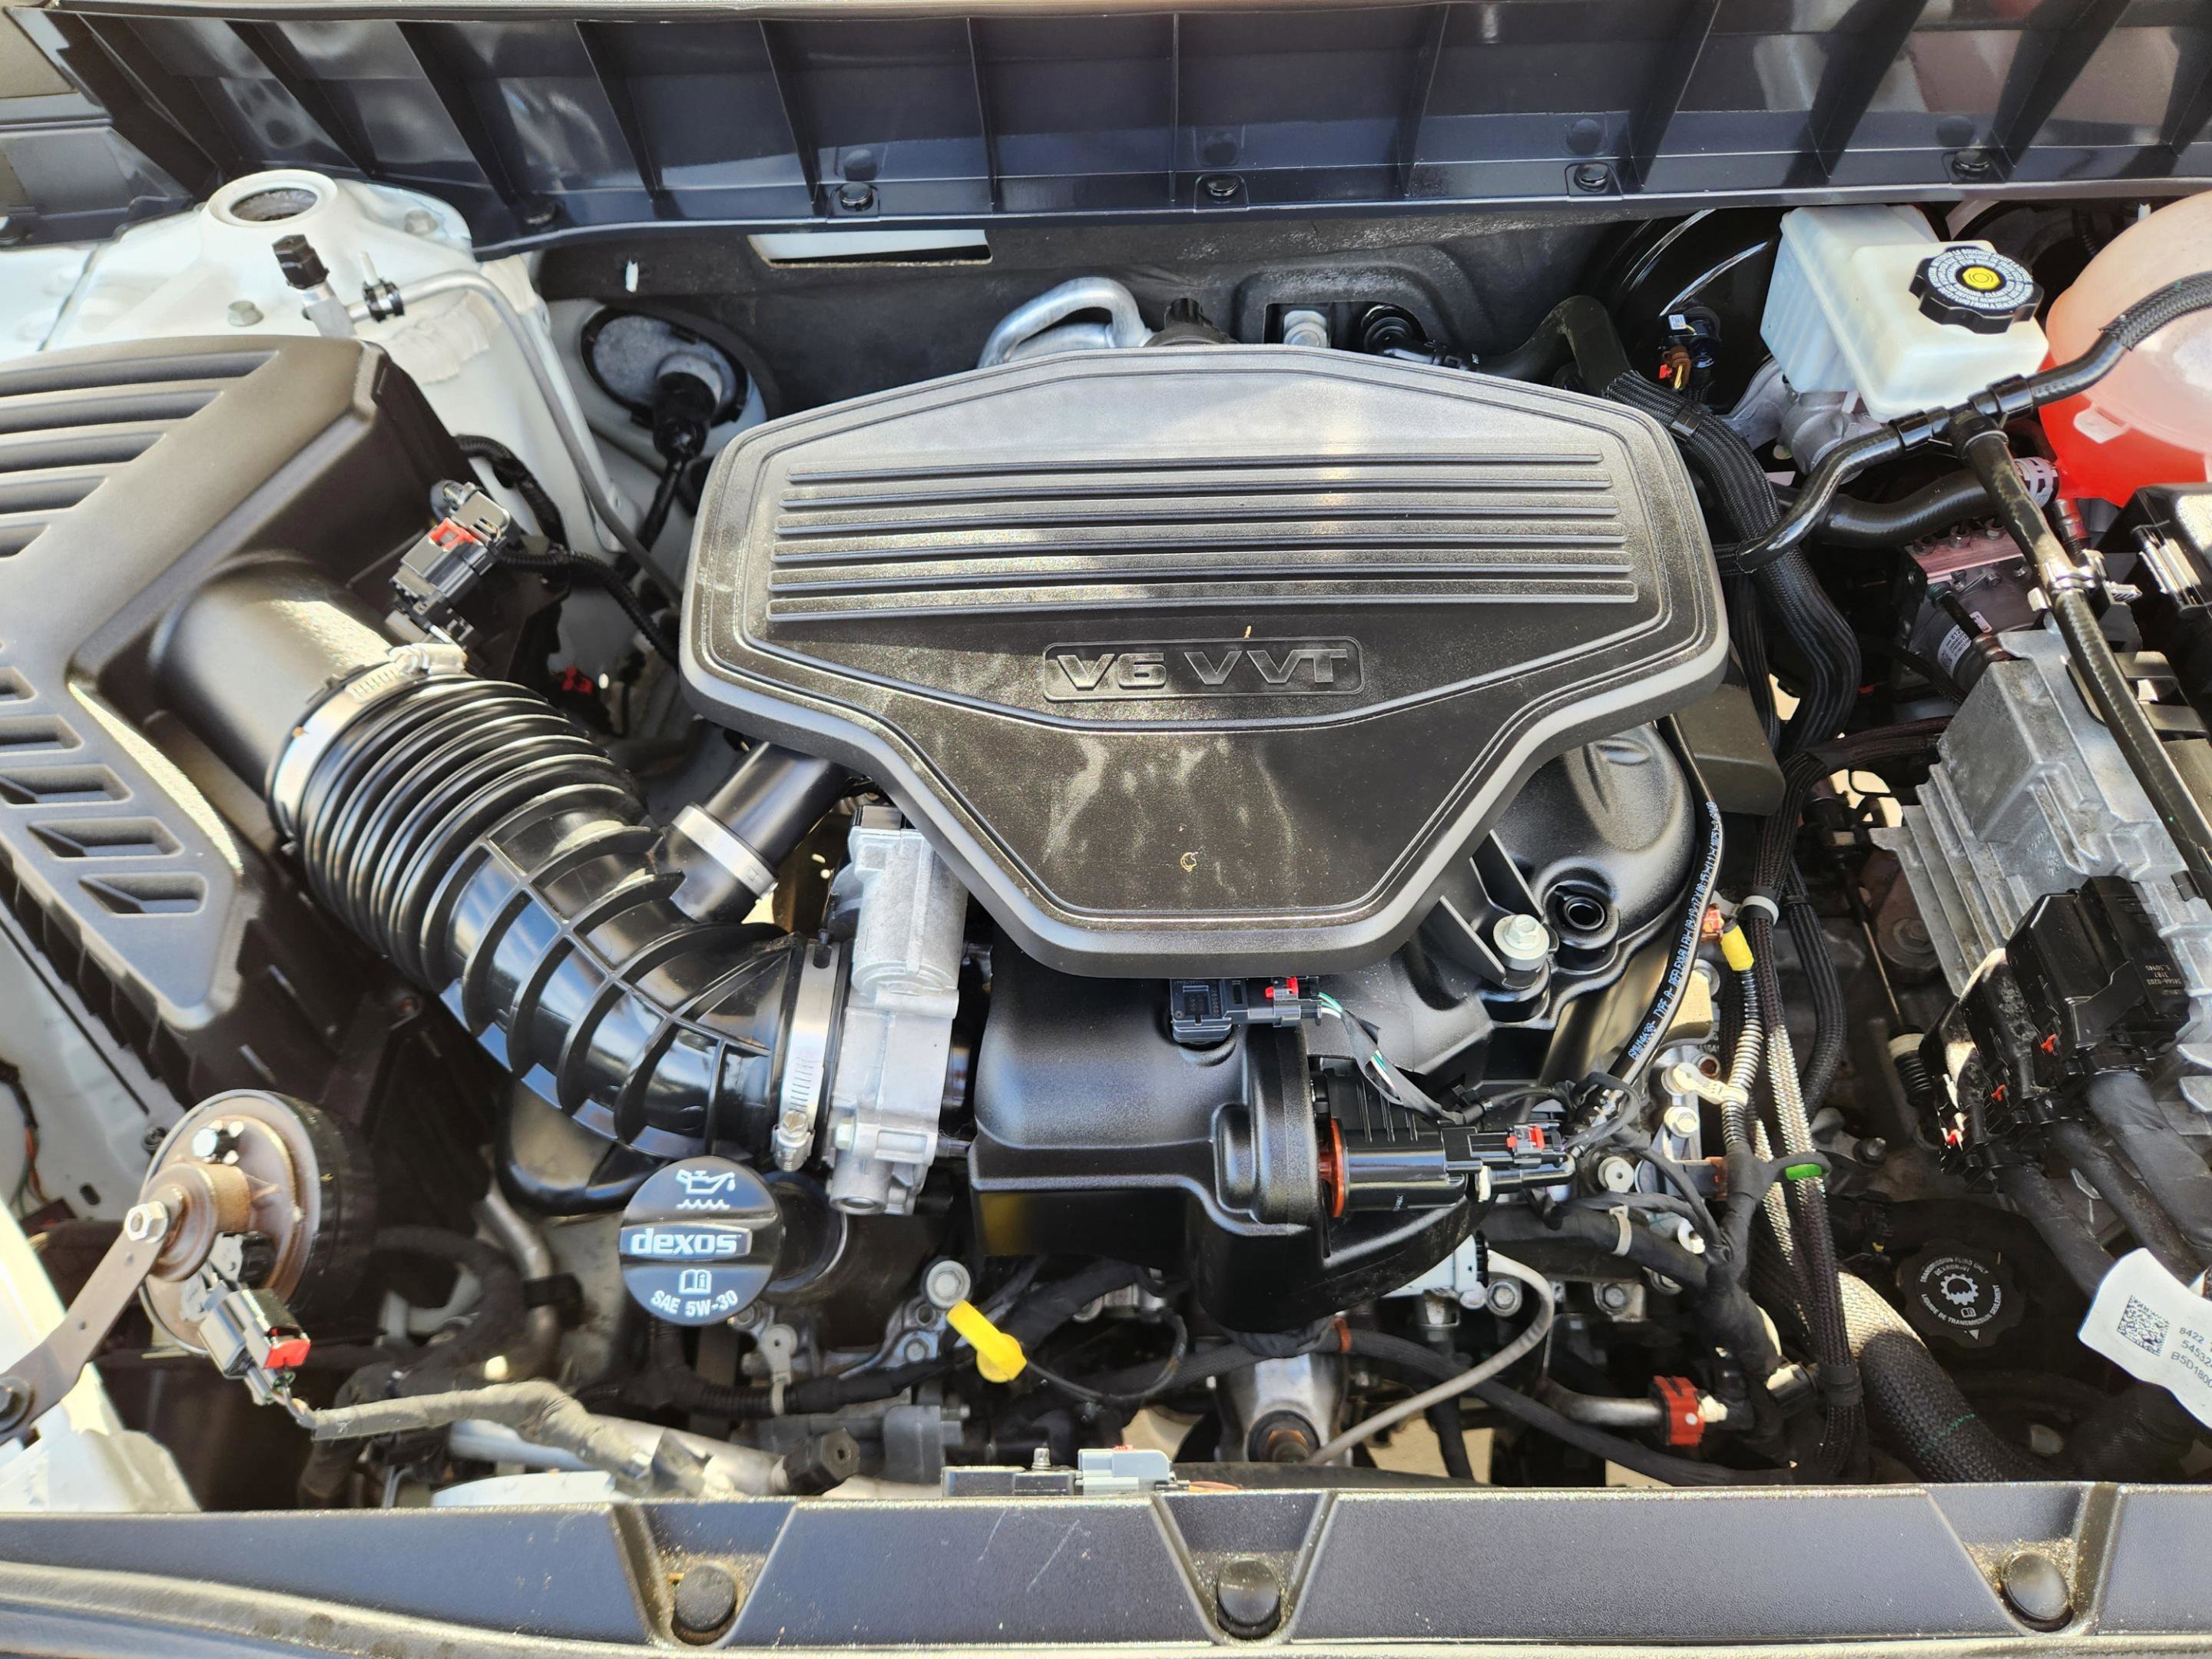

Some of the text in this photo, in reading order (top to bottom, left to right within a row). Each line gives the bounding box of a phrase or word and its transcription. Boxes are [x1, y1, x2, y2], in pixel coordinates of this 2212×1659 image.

[1057, 649, 1348, 689] V6 VVT
[1653, 998, 1671, 1019] TYPE
[631, 1228, 737, 1255] dexos
[651, 1290, 739, 1317] SAE 5W-30
[1938, 1312, 1948, 1320] DE
[2179, 1327, 2204, 1344] 8422
